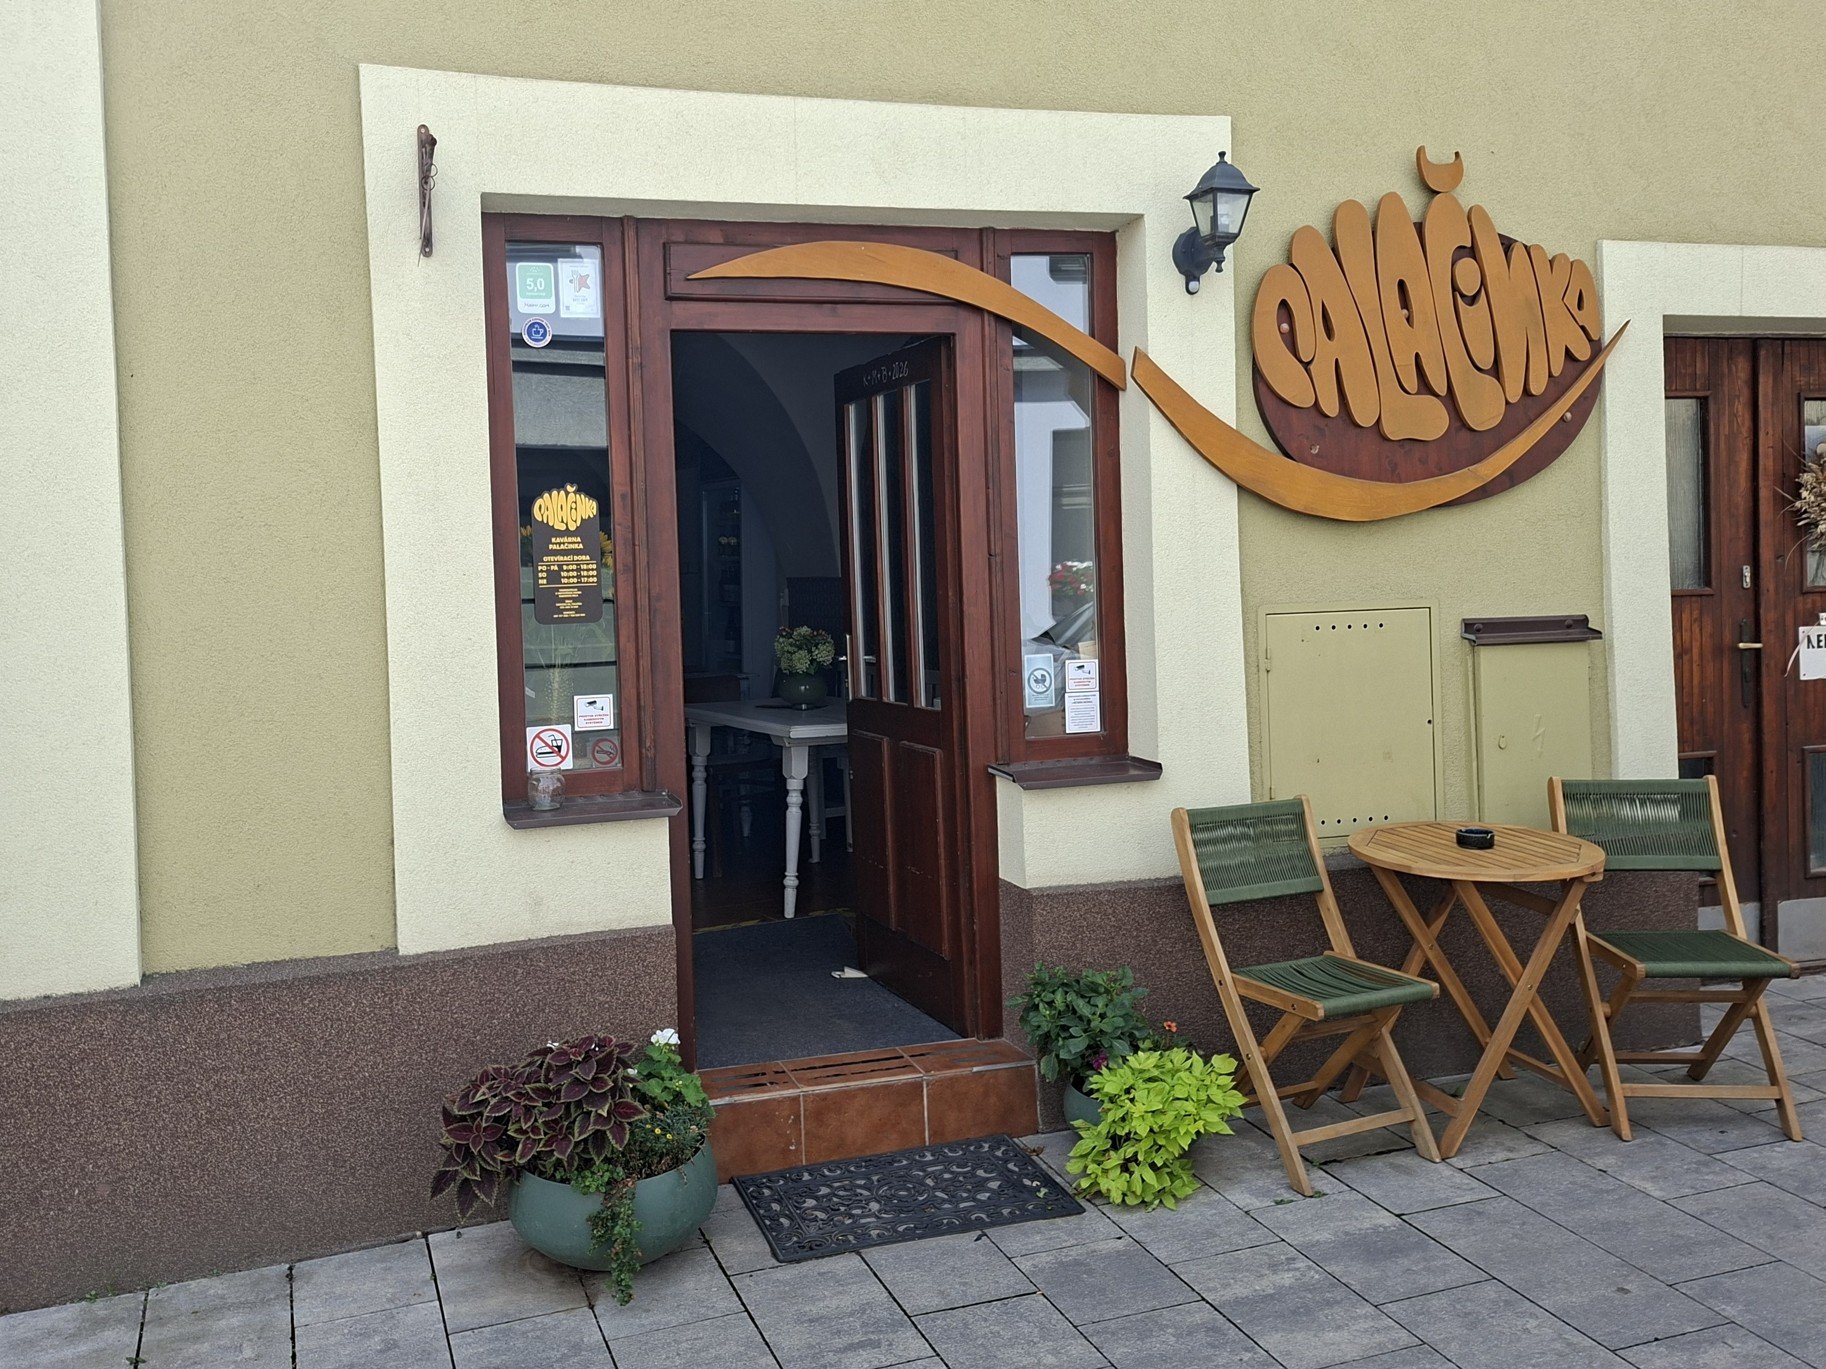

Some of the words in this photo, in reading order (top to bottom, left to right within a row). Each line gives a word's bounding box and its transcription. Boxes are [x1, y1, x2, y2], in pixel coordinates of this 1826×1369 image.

[526, 278, 545, 292] 5,0
[543, 554, 573, 562] OTEVÍRACÍ
[1806, 634, 1826, 650] KE
